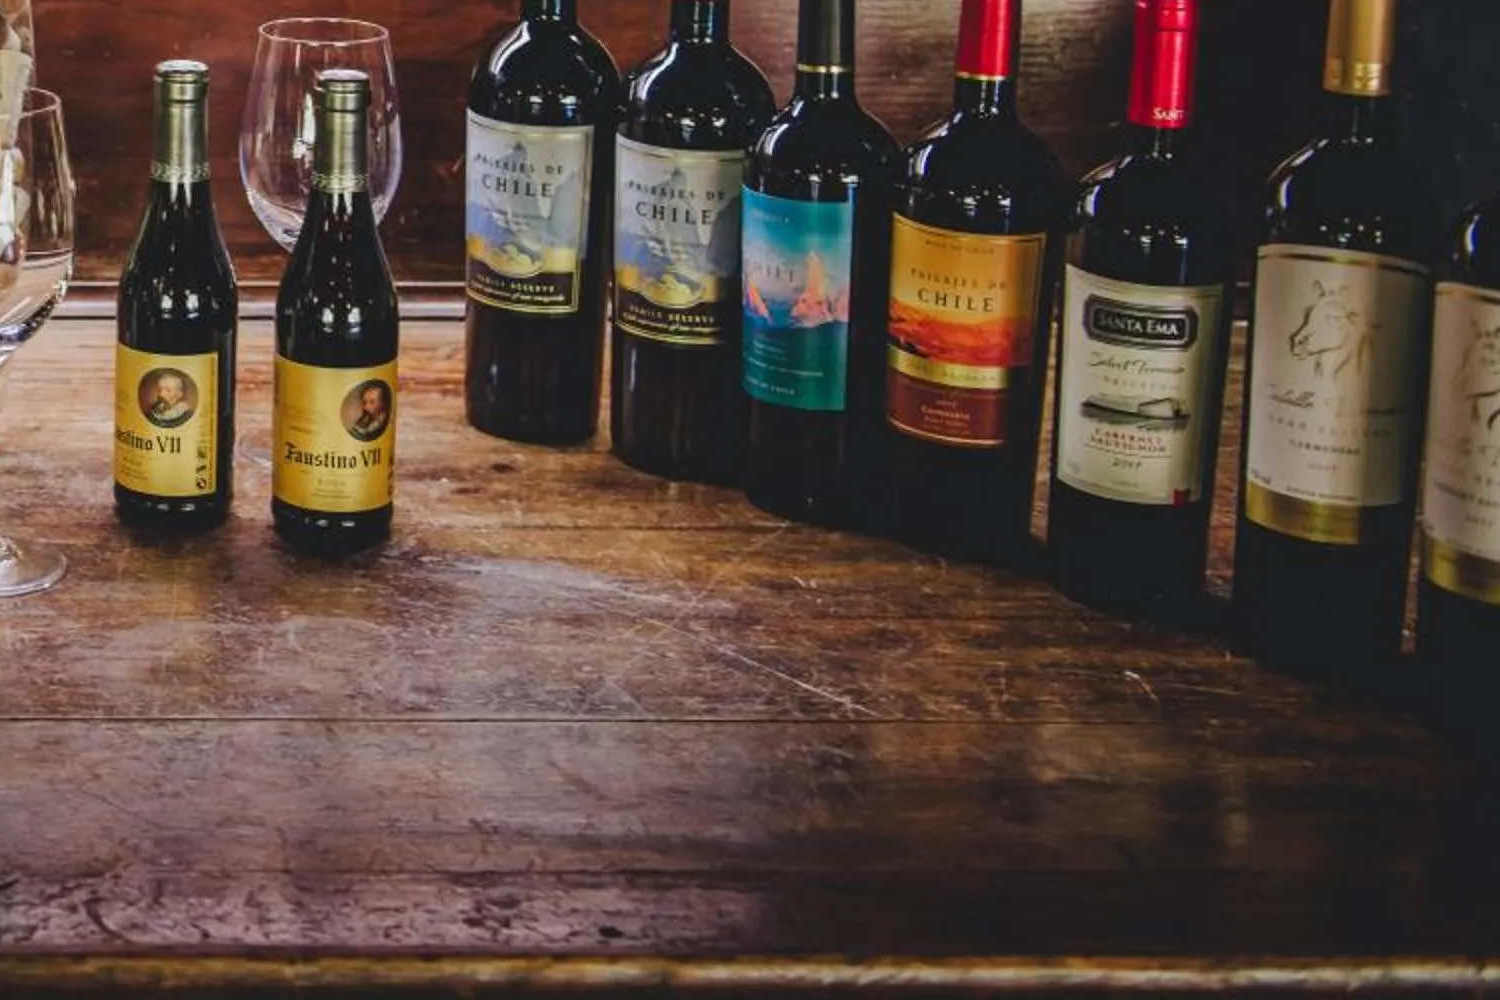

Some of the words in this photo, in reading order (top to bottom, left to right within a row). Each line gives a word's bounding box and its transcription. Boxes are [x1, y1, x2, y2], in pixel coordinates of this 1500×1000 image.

[481, 173, 555, 198] CHILE
[635, 200, 714, 226] CHILE
[917, 287, 996, 313] CHILE
[156, 435, 181, 454] VII
[283, 440, 358, 469] Faustino
[359, 446, 383, 468] VII
